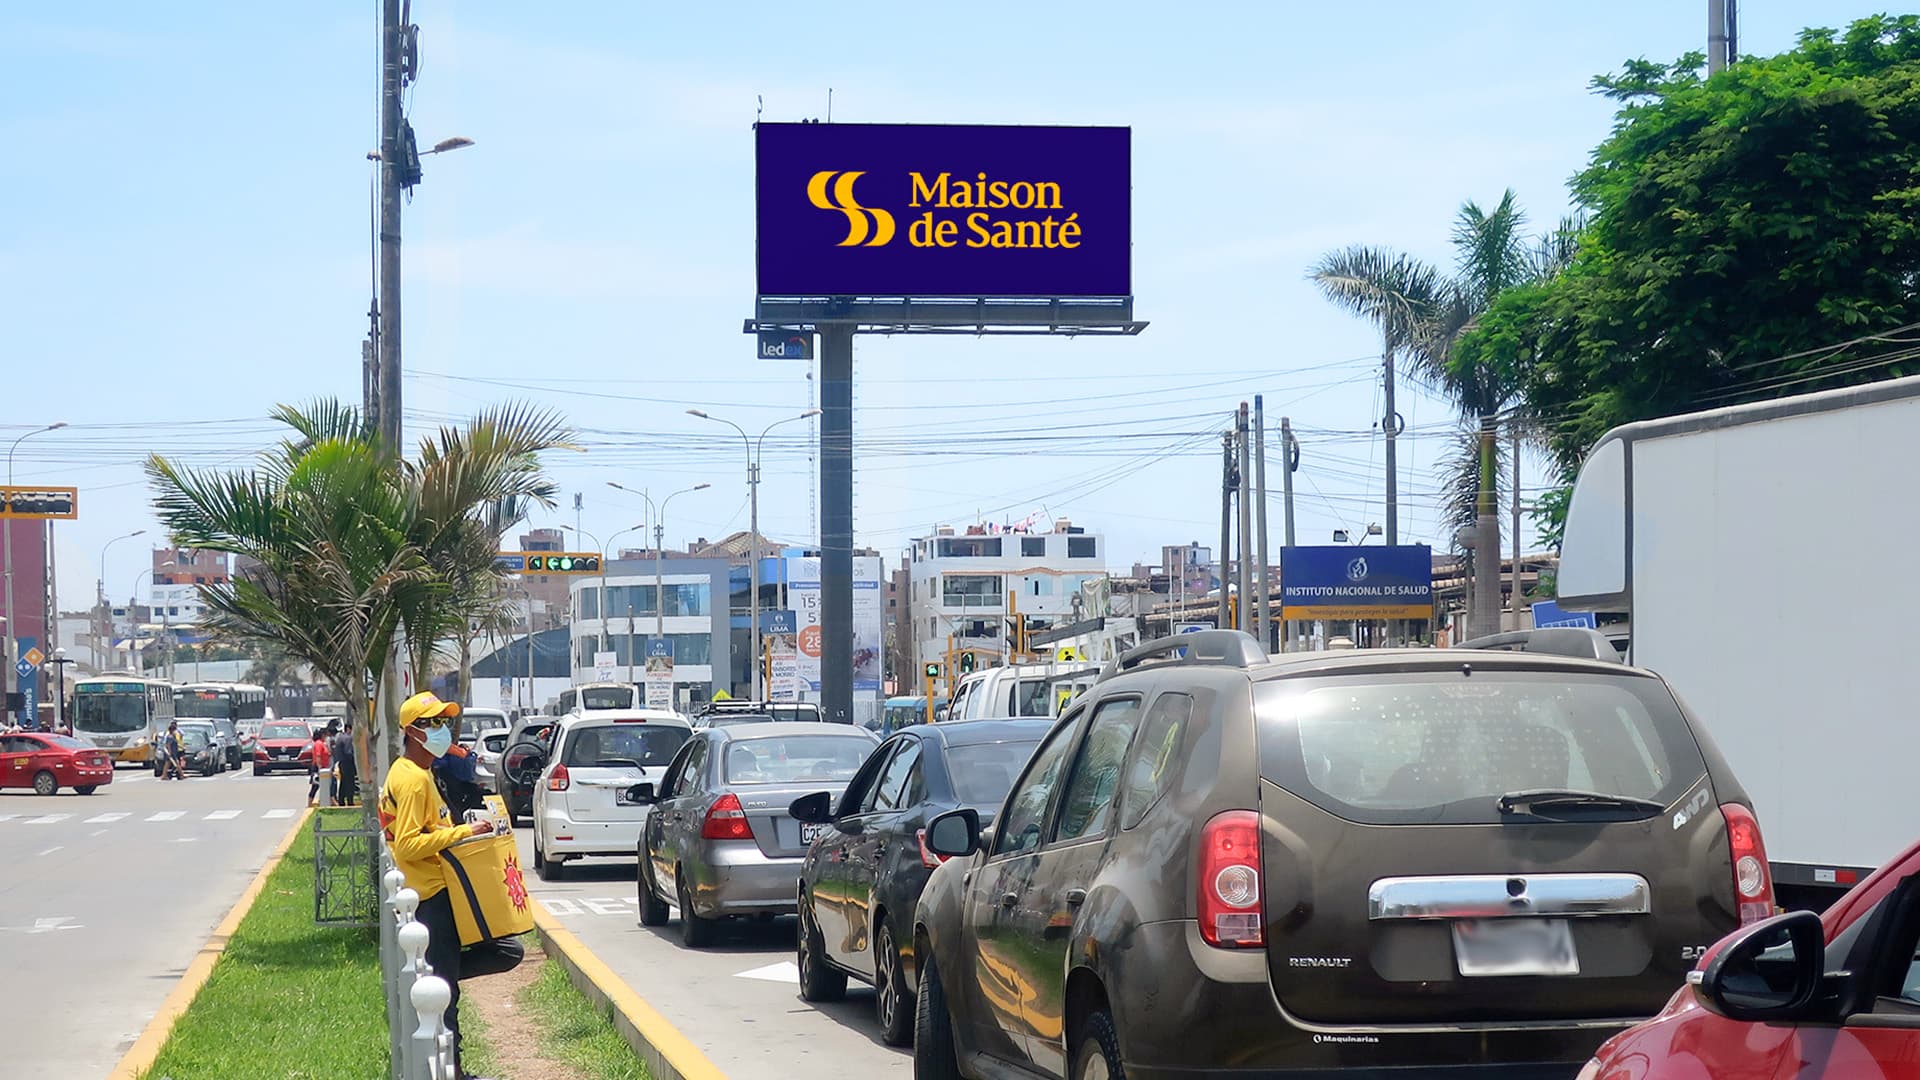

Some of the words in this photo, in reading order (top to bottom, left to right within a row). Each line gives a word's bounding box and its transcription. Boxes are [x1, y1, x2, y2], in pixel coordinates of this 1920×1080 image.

[908, 172, 1064, 209] Maison
[908, 212, 958, 248] de
[966, 212, 1082, 249] Santé
[1286, 586, 1334, 597] INSTITUTO
[1335, 586, 1382, 596] NACIONAL
[1384, 586, 1397, 596] DE
[1398, 585, 1429, 595] SALUD
[1673, 788, 1709, 830] 4WD
[1289, 958, 1352, 968] RENAULT
[1323, 1035, 1380, 1044] Maquinarias
